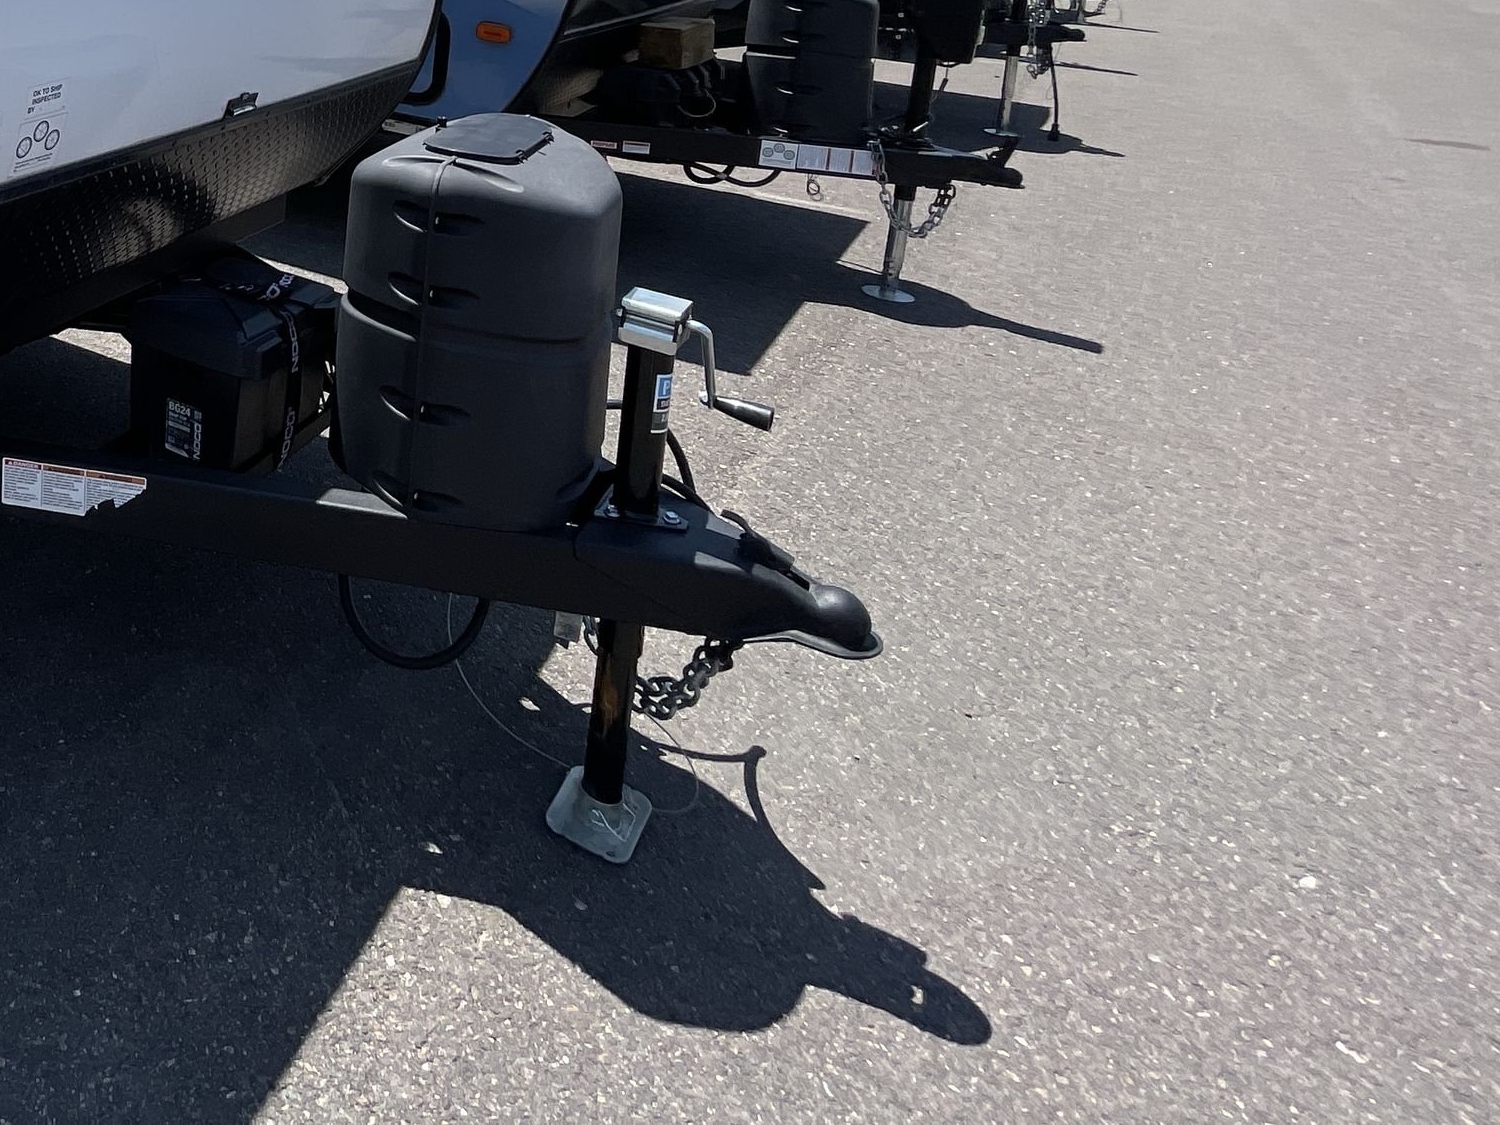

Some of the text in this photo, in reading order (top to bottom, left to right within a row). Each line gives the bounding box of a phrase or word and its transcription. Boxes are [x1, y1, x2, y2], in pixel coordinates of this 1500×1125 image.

[31, 91, 62, 105] INSPECTED
[32, 83, 63, 98] OK TO SHIP
[168, 401, 191, 417] BG24
[193, 422, 202, 460] NOCO
